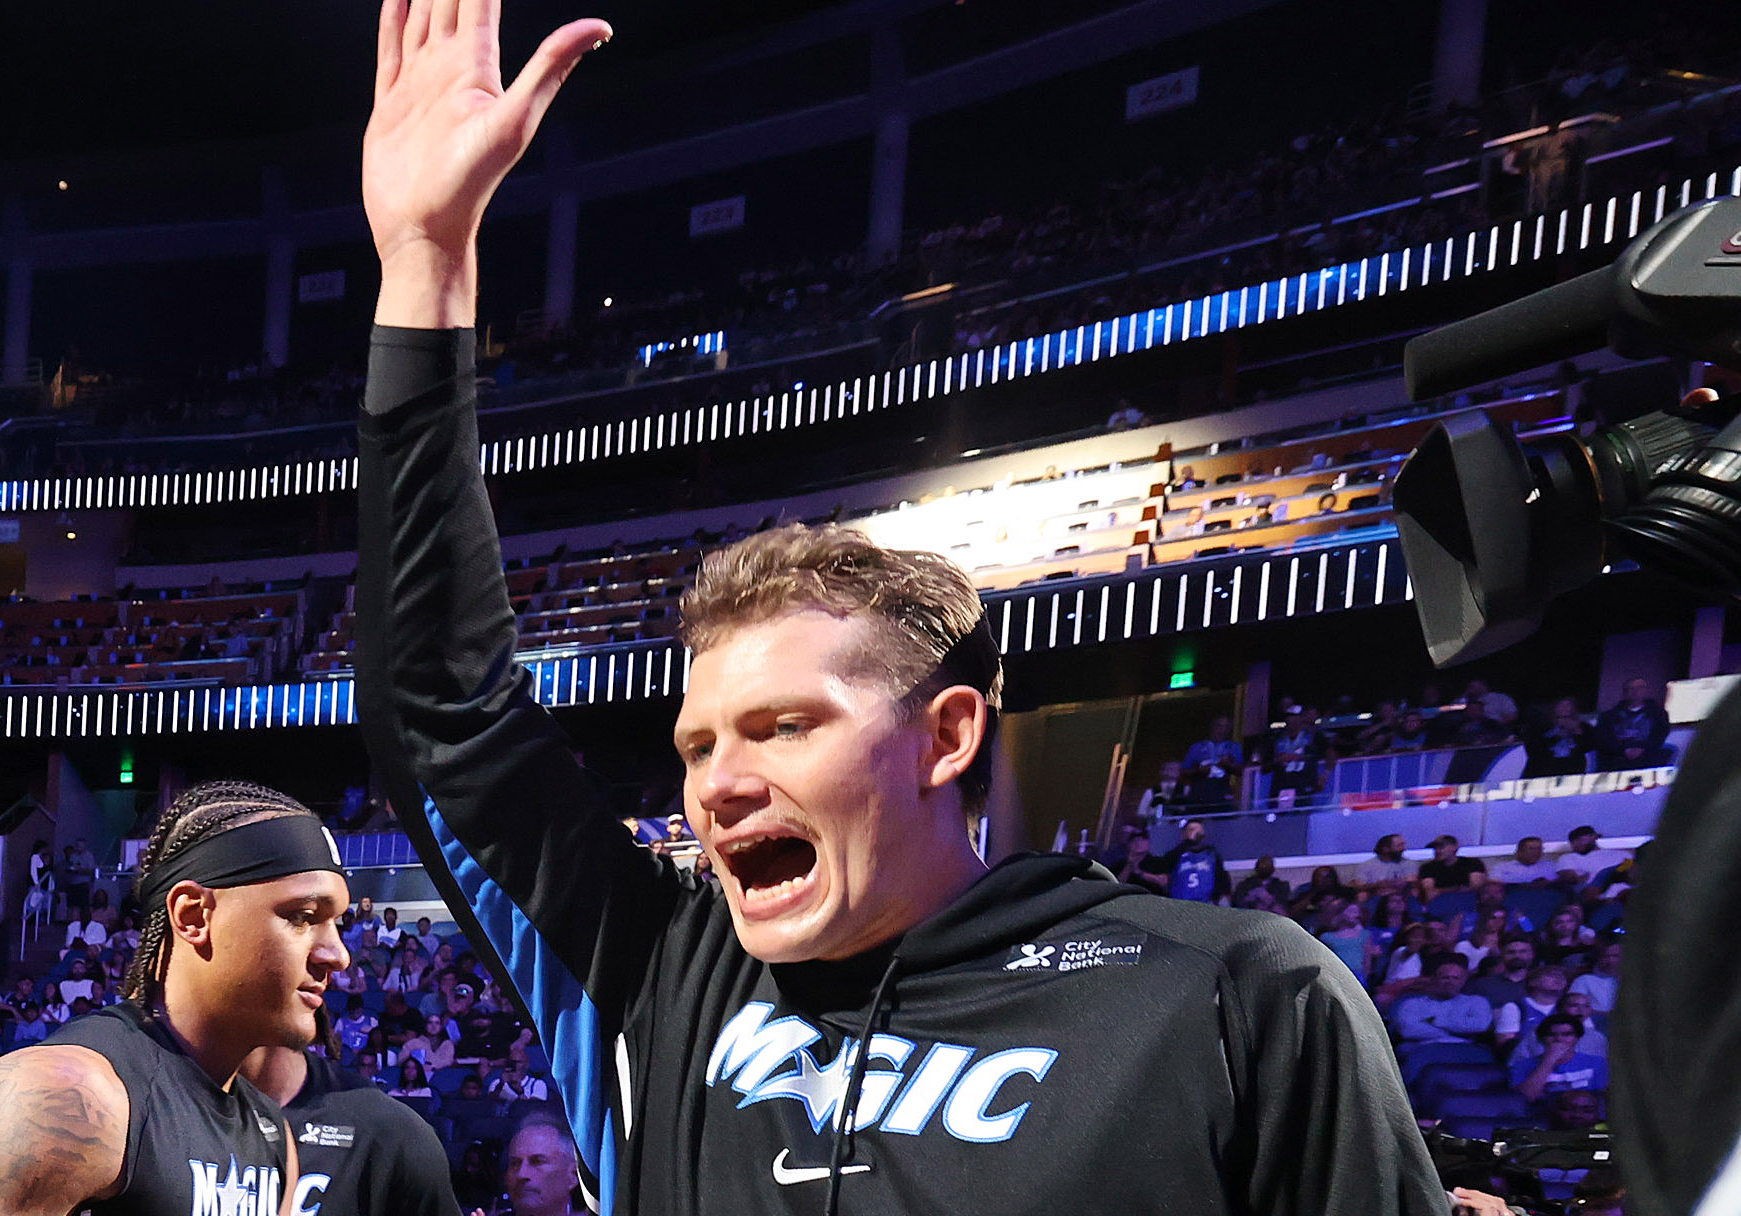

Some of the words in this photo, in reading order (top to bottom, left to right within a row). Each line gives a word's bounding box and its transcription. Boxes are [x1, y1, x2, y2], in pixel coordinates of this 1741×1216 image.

[1061, 944, 1142, 962] National
[1065, 939, 1102, 953] City
[1059, 956, 1104, 972] Bank
